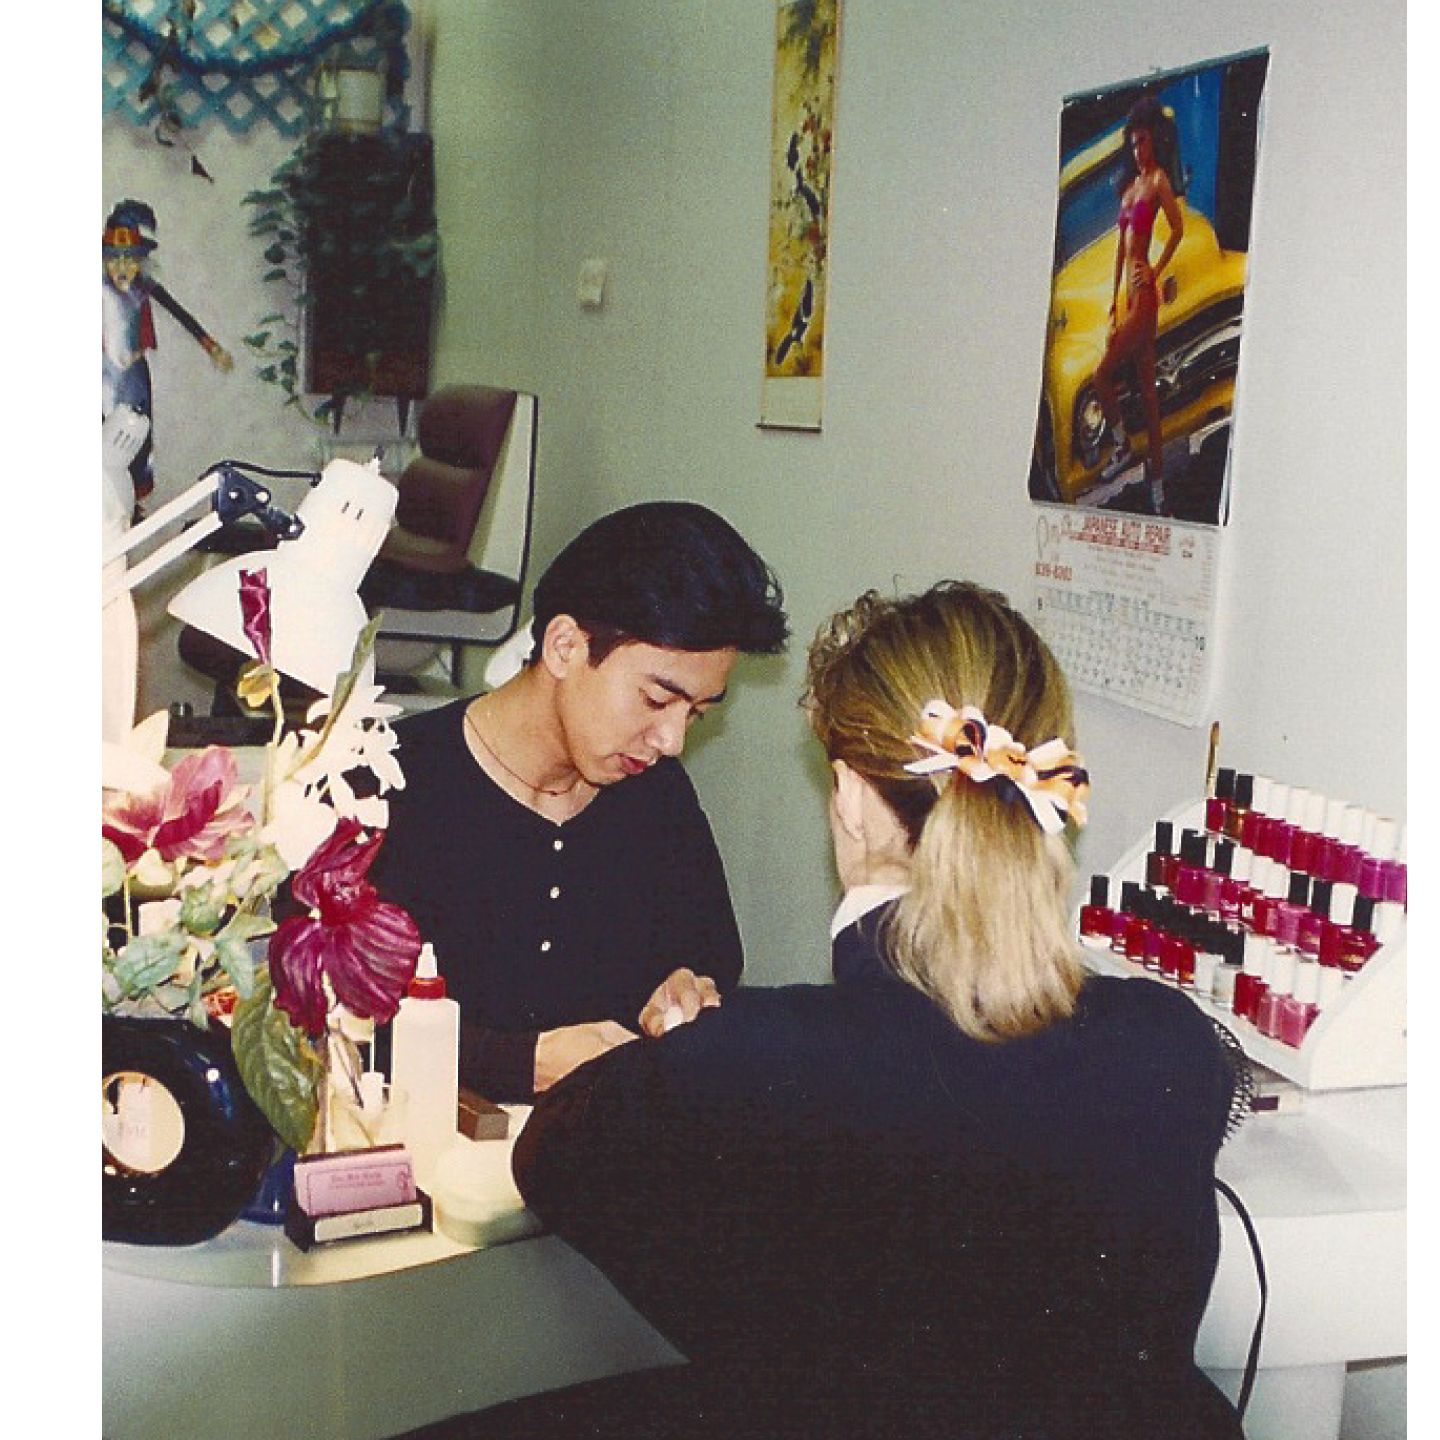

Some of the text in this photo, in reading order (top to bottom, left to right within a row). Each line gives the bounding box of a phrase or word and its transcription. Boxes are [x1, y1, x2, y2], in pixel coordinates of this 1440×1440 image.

[1082, 514, 1118, 535] JAPANESE
[1121, 519, 1141, 540] AUTO
[1145, 524, 1172, 547] REPAIR
